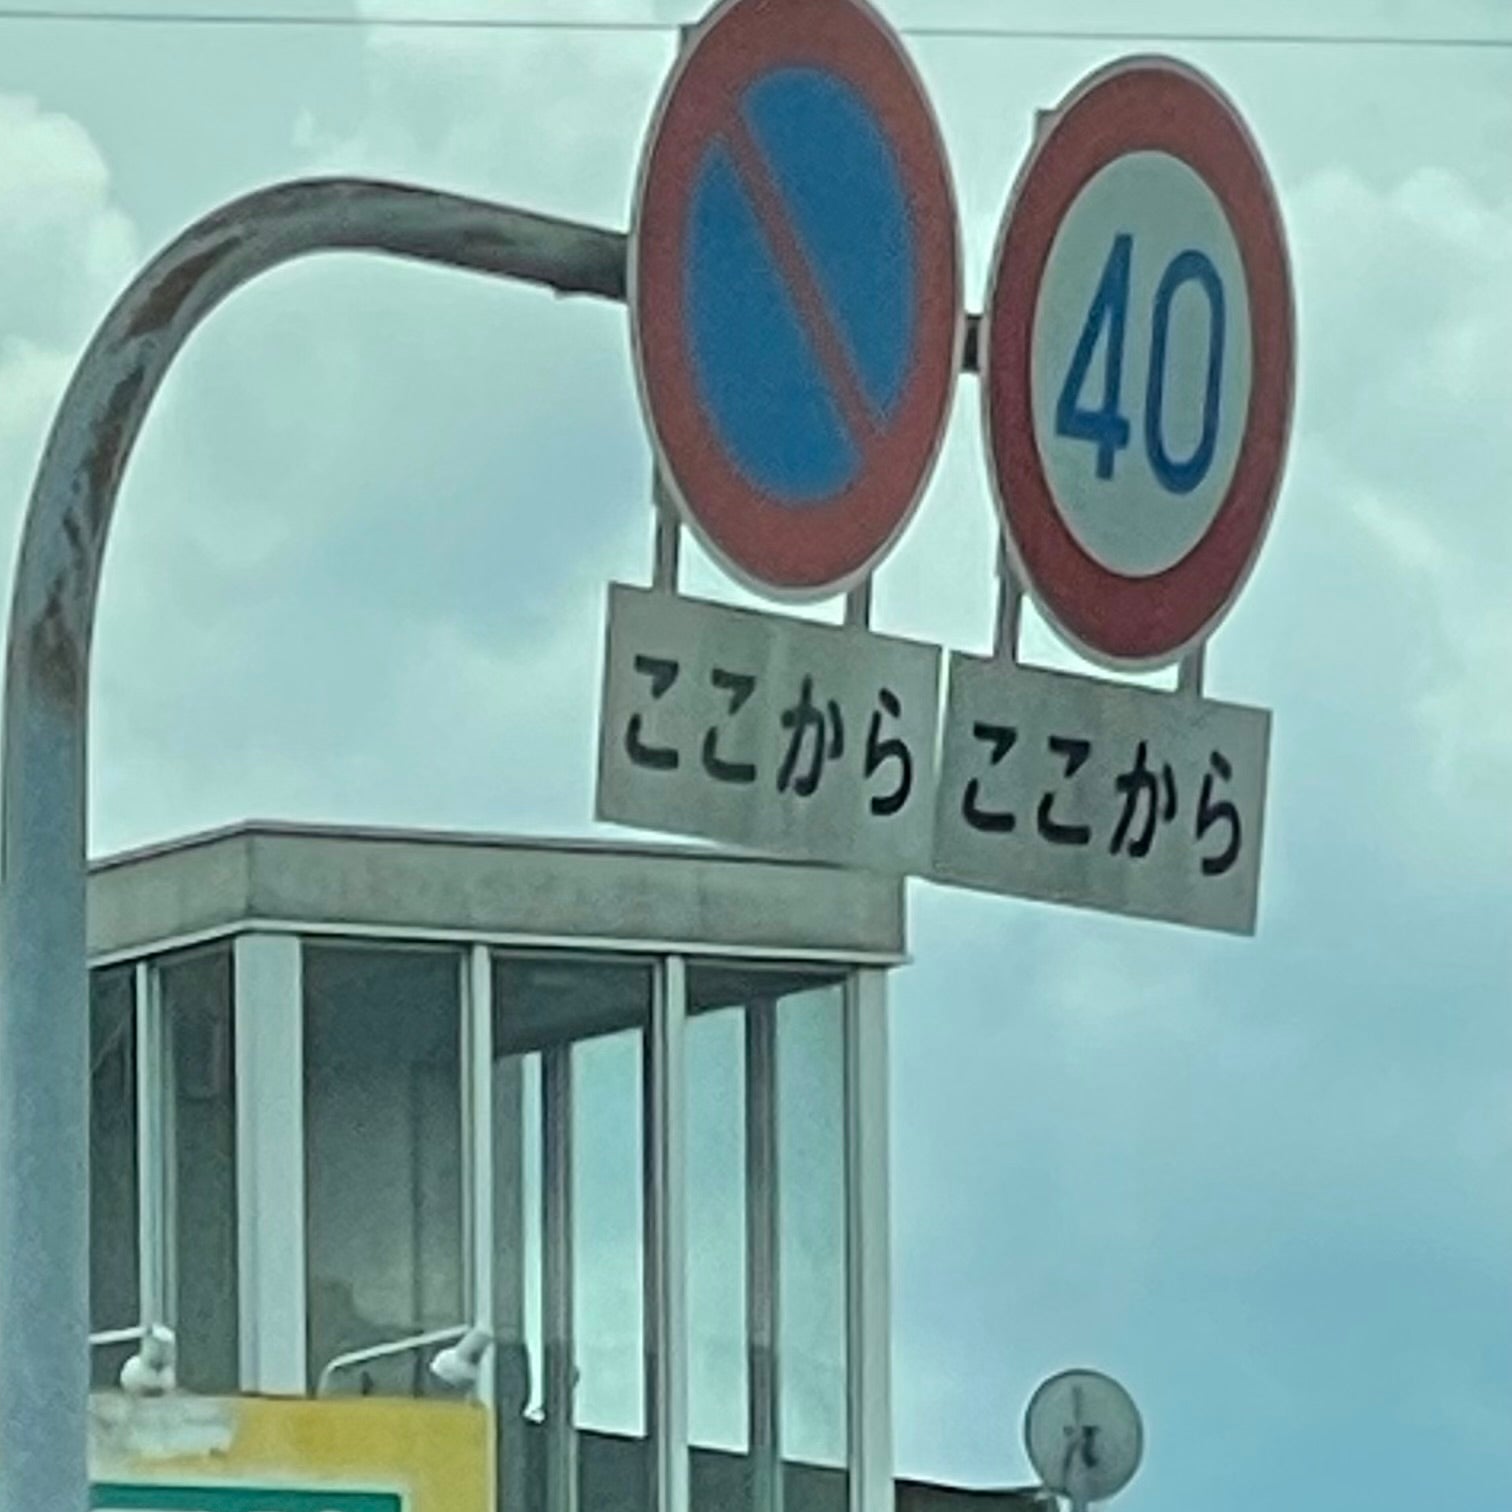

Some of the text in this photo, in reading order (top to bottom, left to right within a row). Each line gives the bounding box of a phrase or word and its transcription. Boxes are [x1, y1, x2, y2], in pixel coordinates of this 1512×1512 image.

[1056, 234, 1226, 494] 40
[625, 654, 912, 817] ここから
[962, 721, 1242, 876] ここから
